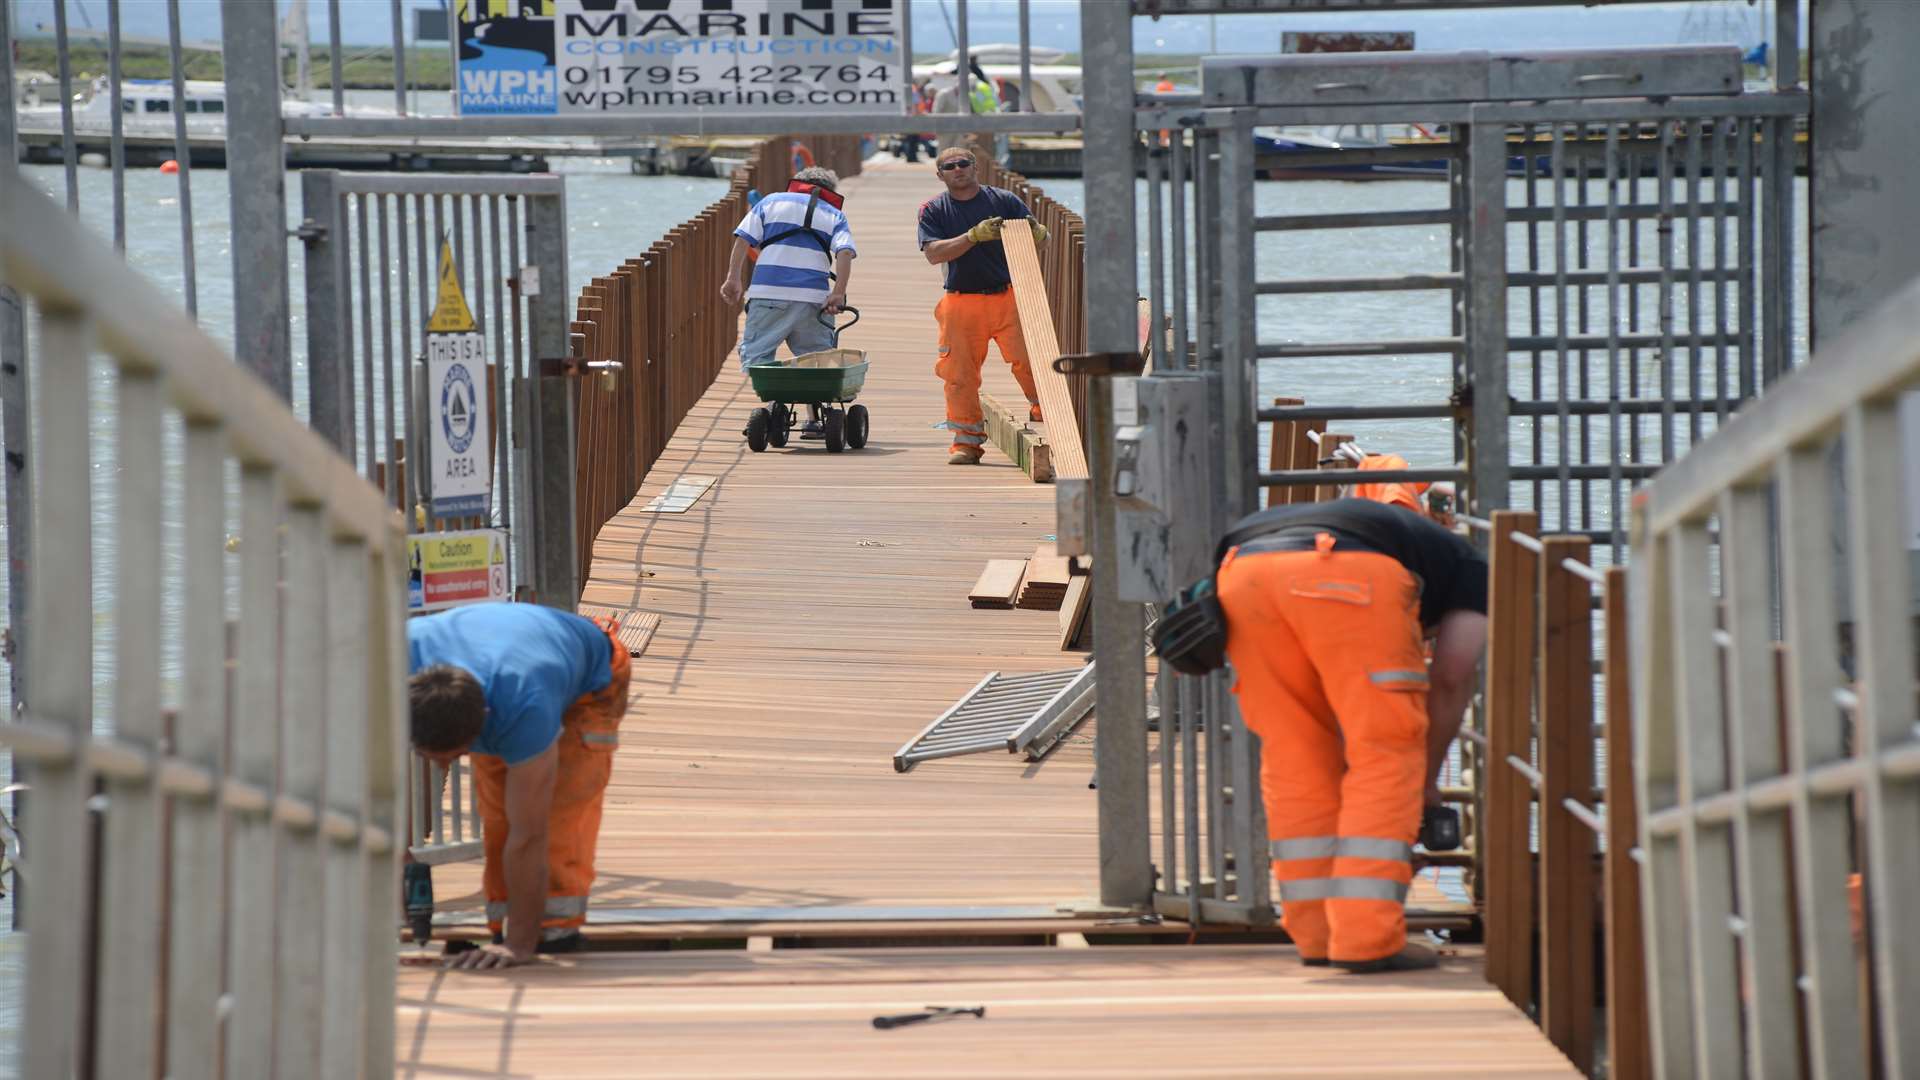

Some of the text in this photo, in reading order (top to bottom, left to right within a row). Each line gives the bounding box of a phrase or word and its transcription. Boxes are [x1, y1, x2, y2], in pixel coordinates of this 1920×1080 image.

[565, 13, 895, 36] MARINE
[566, 38, 894, 55] CONSTRUCTION
[462, 69, 554, 94] WPH
[565, 65, 892, 85] 01795 422764
[463, 94, 554, 105] MARINE
[564, 86, 897, 110] wphmarine.com
[431, 339, 483, 361] THIS IS A
[447, 457, 476, 479] AREA
[439, 541, 473, 558] Caution
